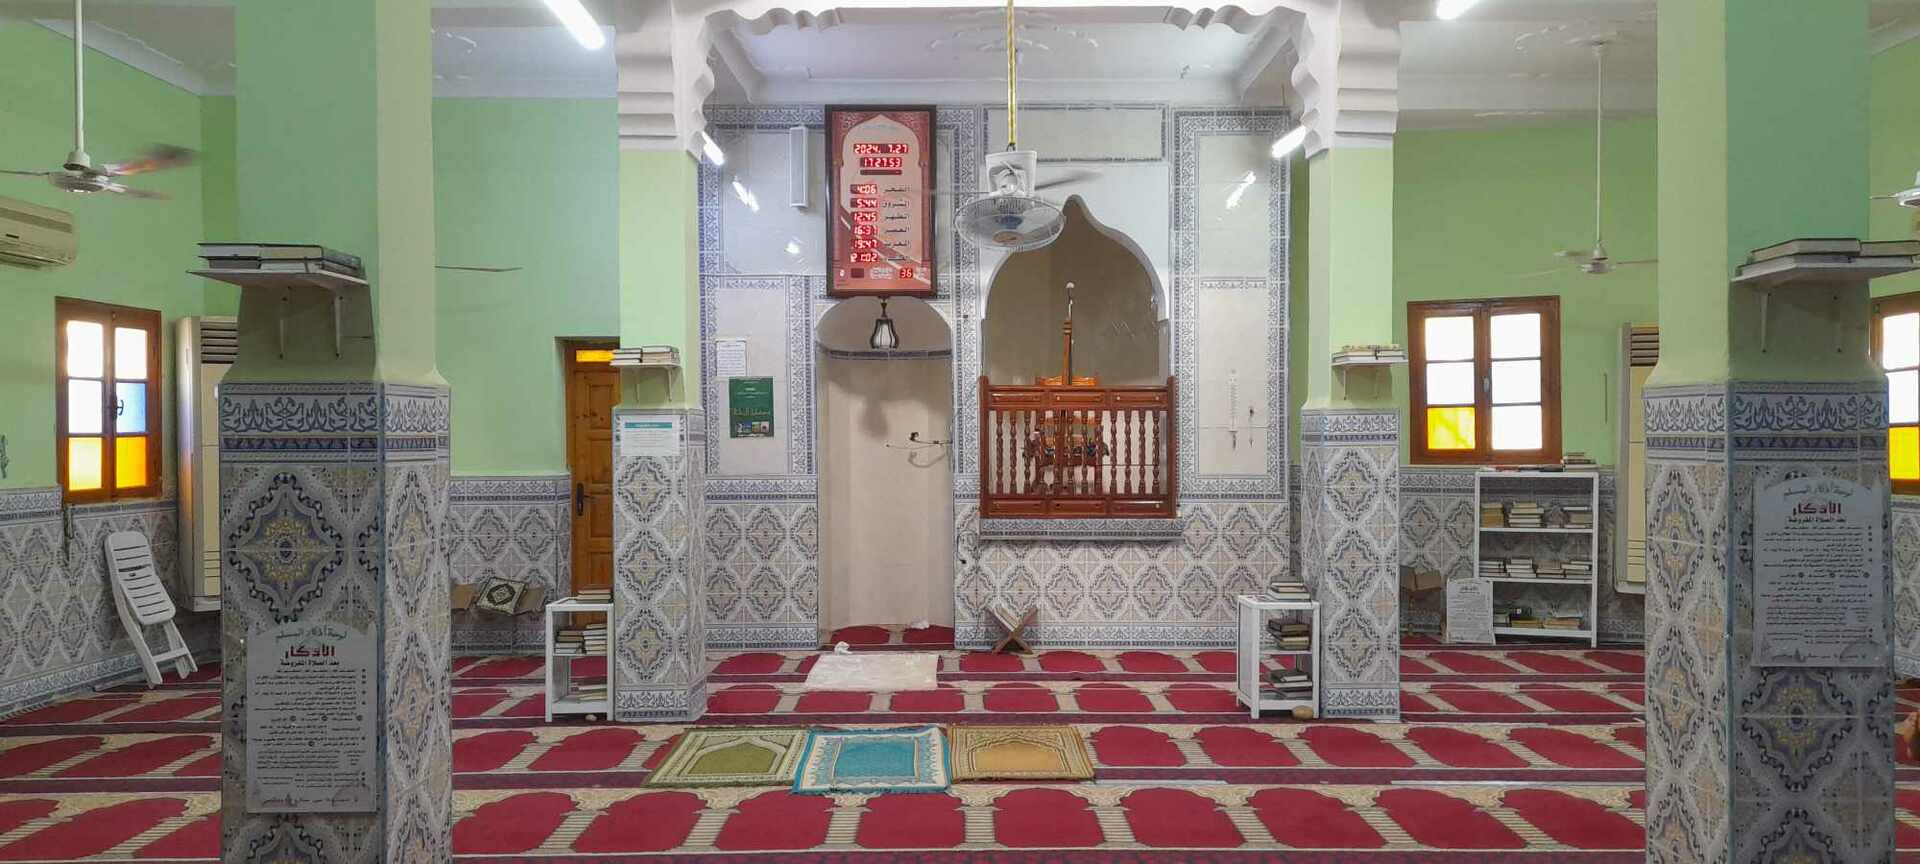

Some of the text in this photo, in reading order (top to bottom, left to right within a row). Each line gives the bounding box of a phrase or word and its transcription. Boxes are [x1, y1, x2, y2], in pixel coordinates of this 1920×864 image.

[856, 184, 876, 194] 4:06
[856, 198, 877, 208] 5:44
[853, 212, 877, 222] 12:45
